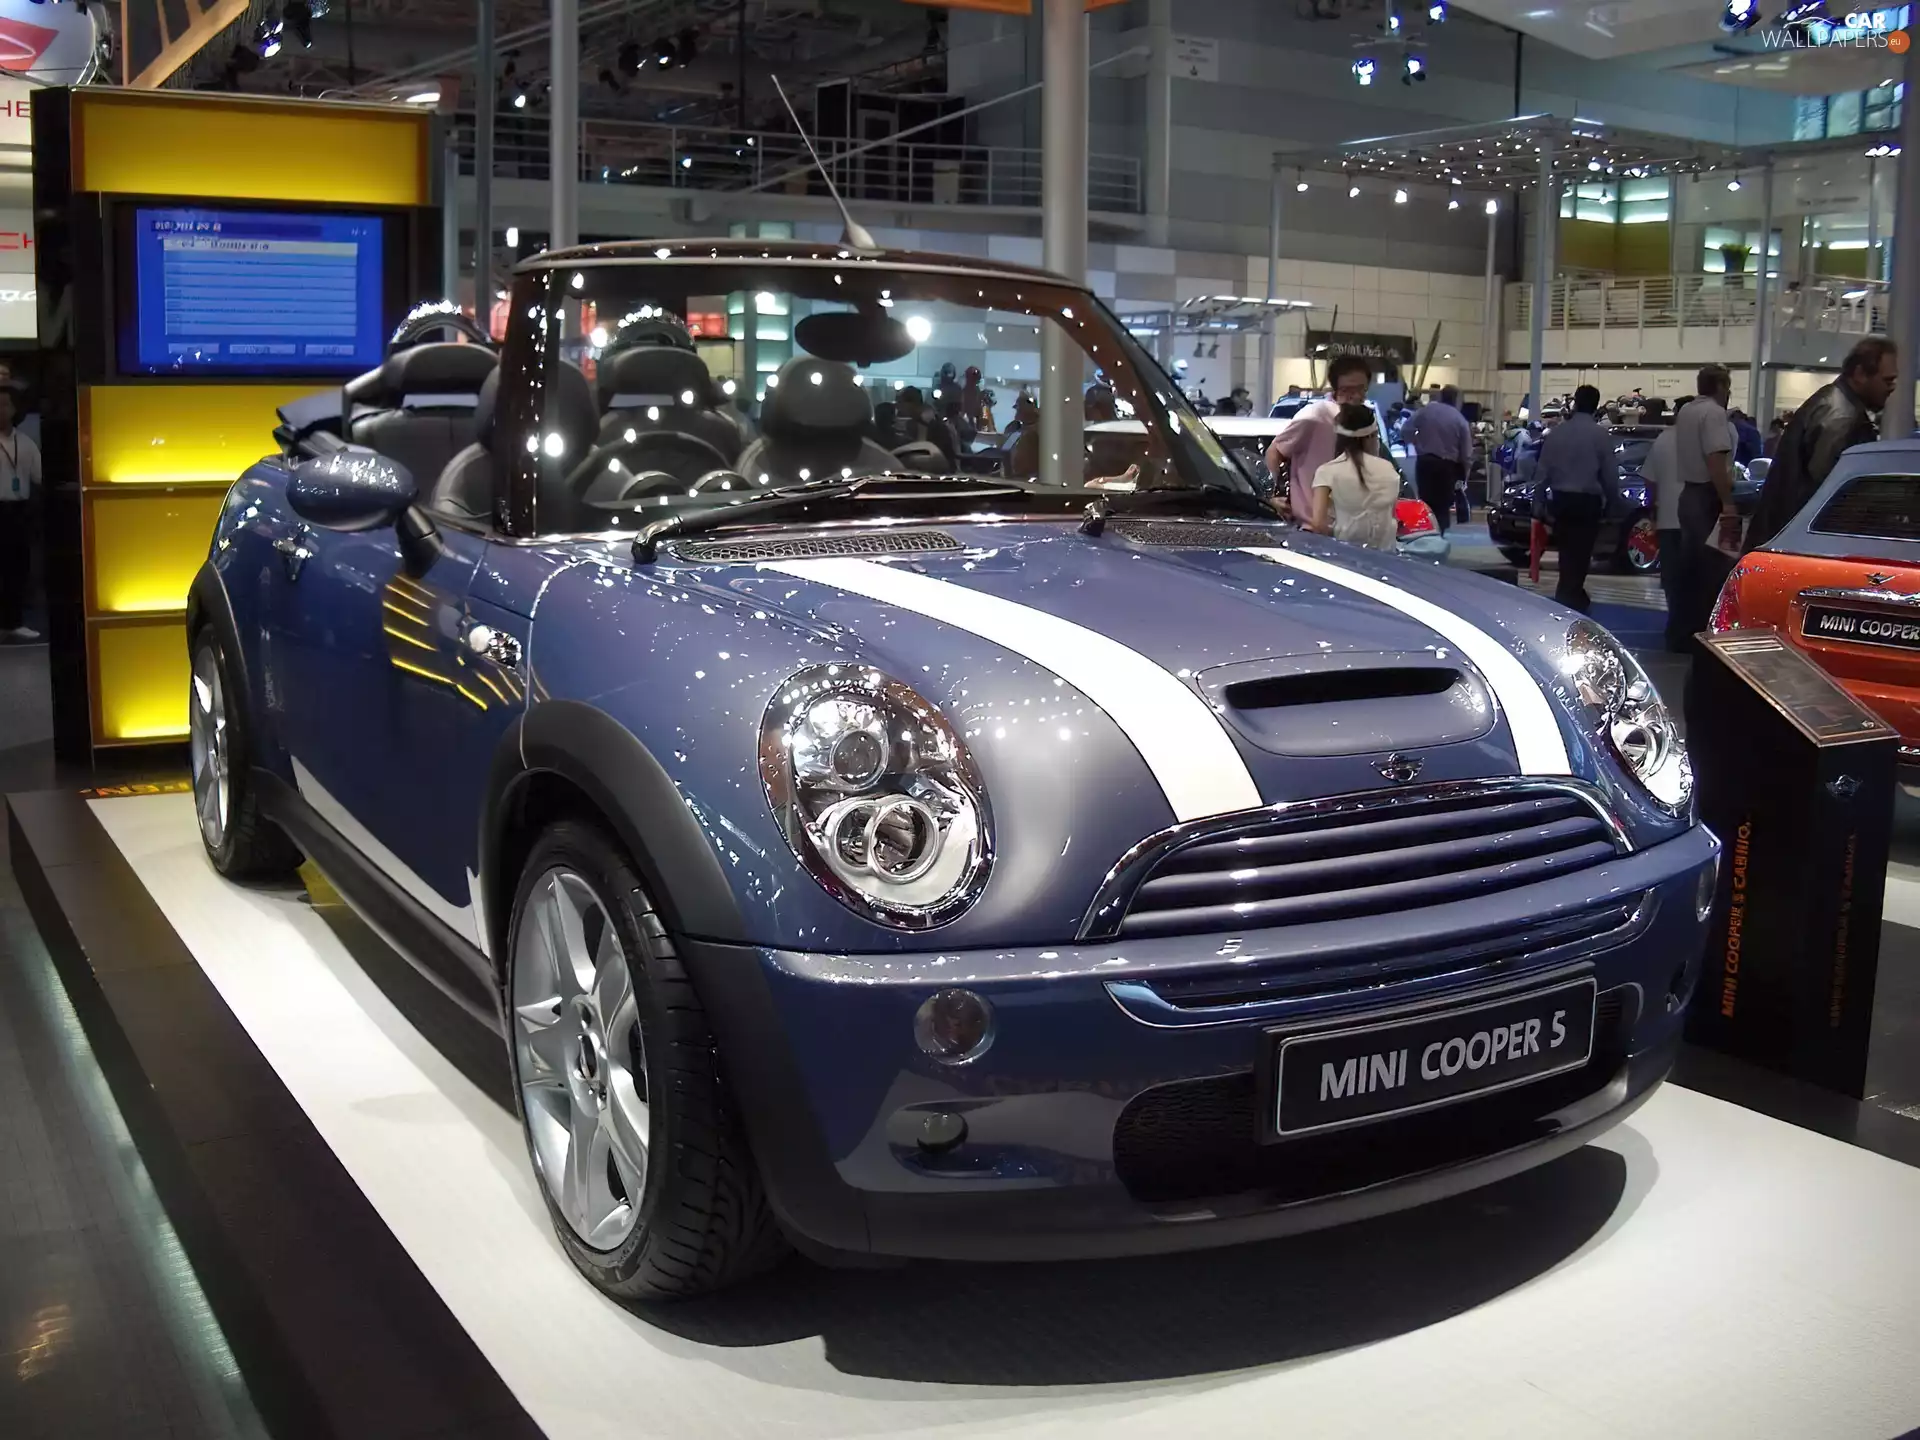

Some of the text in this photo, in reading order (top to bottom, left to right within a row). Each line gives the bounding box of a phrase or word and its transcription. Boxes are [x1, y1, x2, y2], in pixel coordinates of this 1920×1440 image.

[1820, 614, 1920, 640] MINI COOPER
[1319, 1010, 1567, 1102] MINI COOPER S
